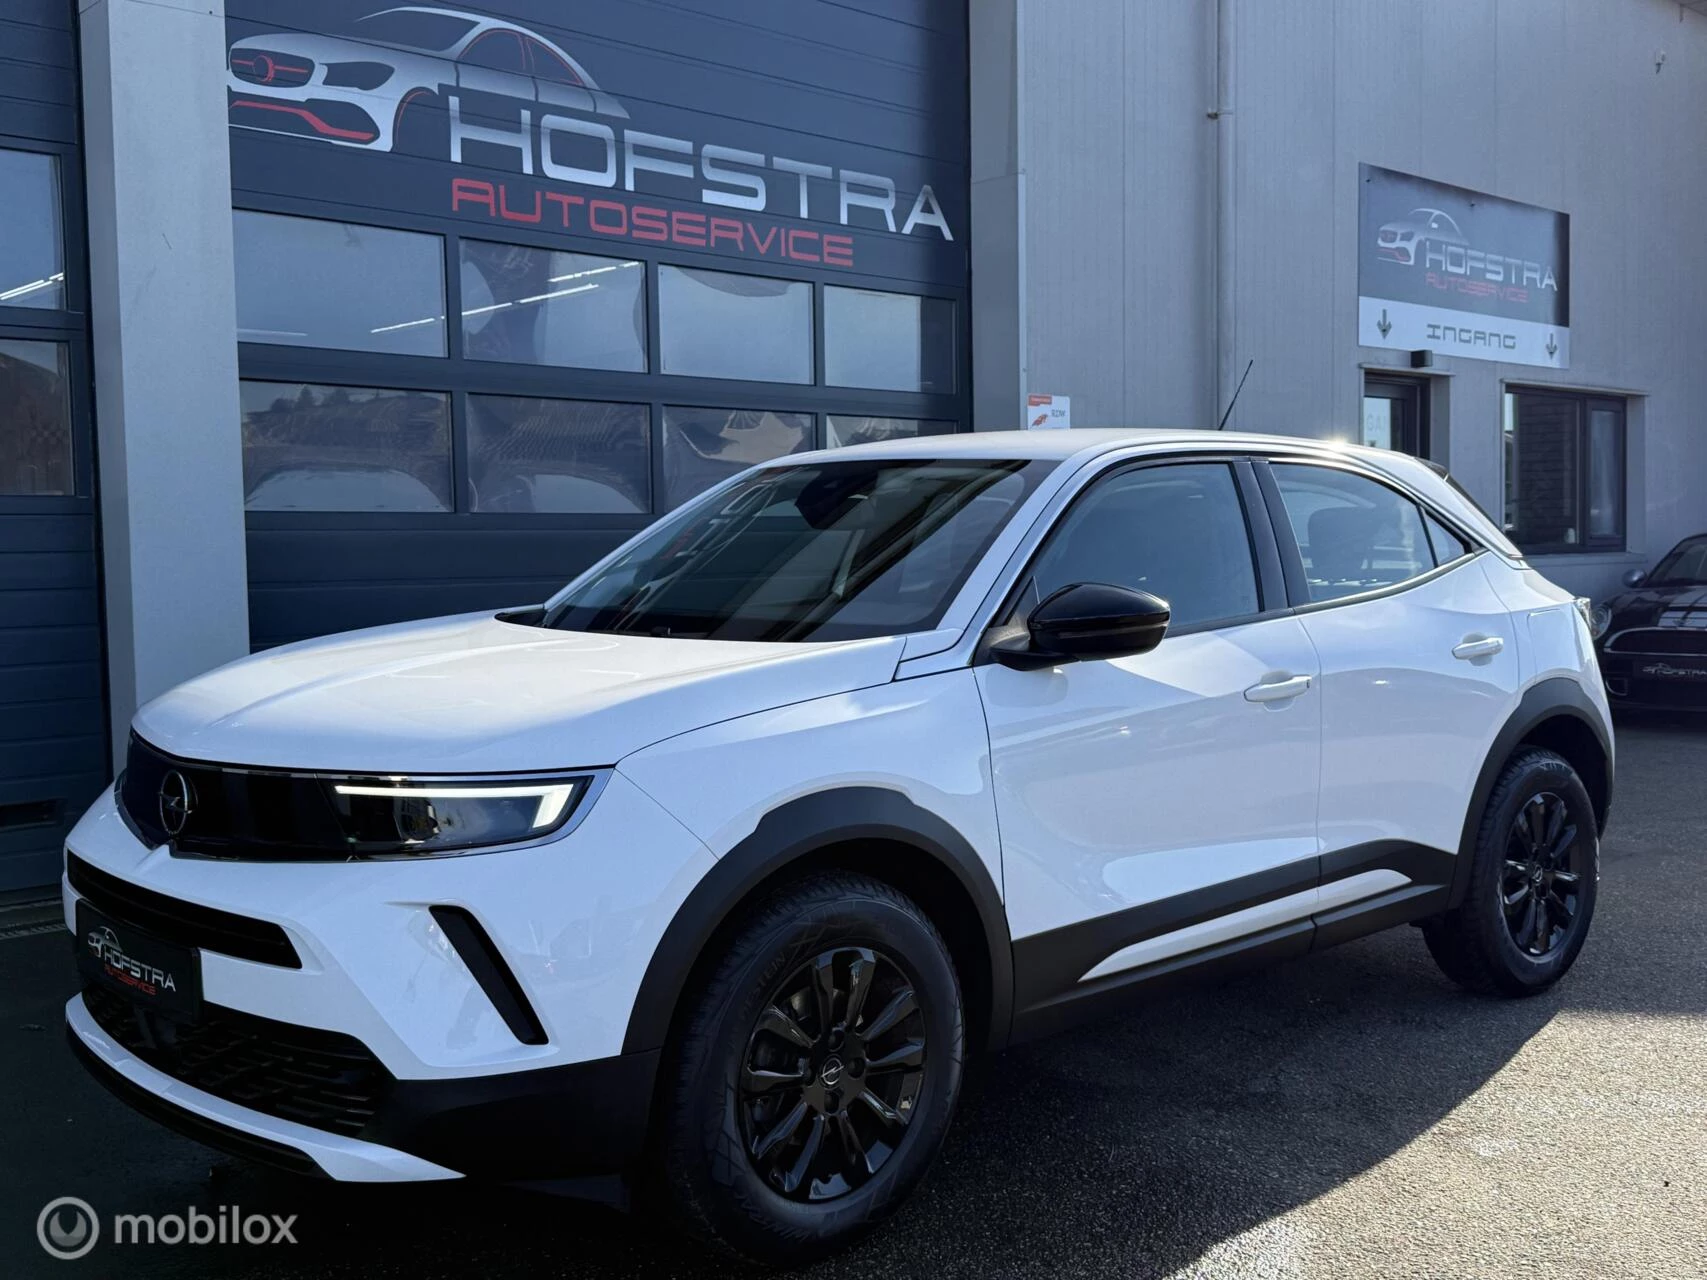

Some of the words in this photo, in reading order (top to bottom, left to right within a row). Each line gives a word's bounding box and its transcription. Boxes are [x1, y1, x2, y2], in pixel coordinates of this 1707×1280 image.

[449, 96, 954, 241] HOFSTRA
[452, 178, 853, 266] AUTOSERVICE
[1426, 241, 1557, 291] HOFSTRA
[1427, 323, 1516, 349] INGANG
[104, 946, 176, 992] HOFSTRA
